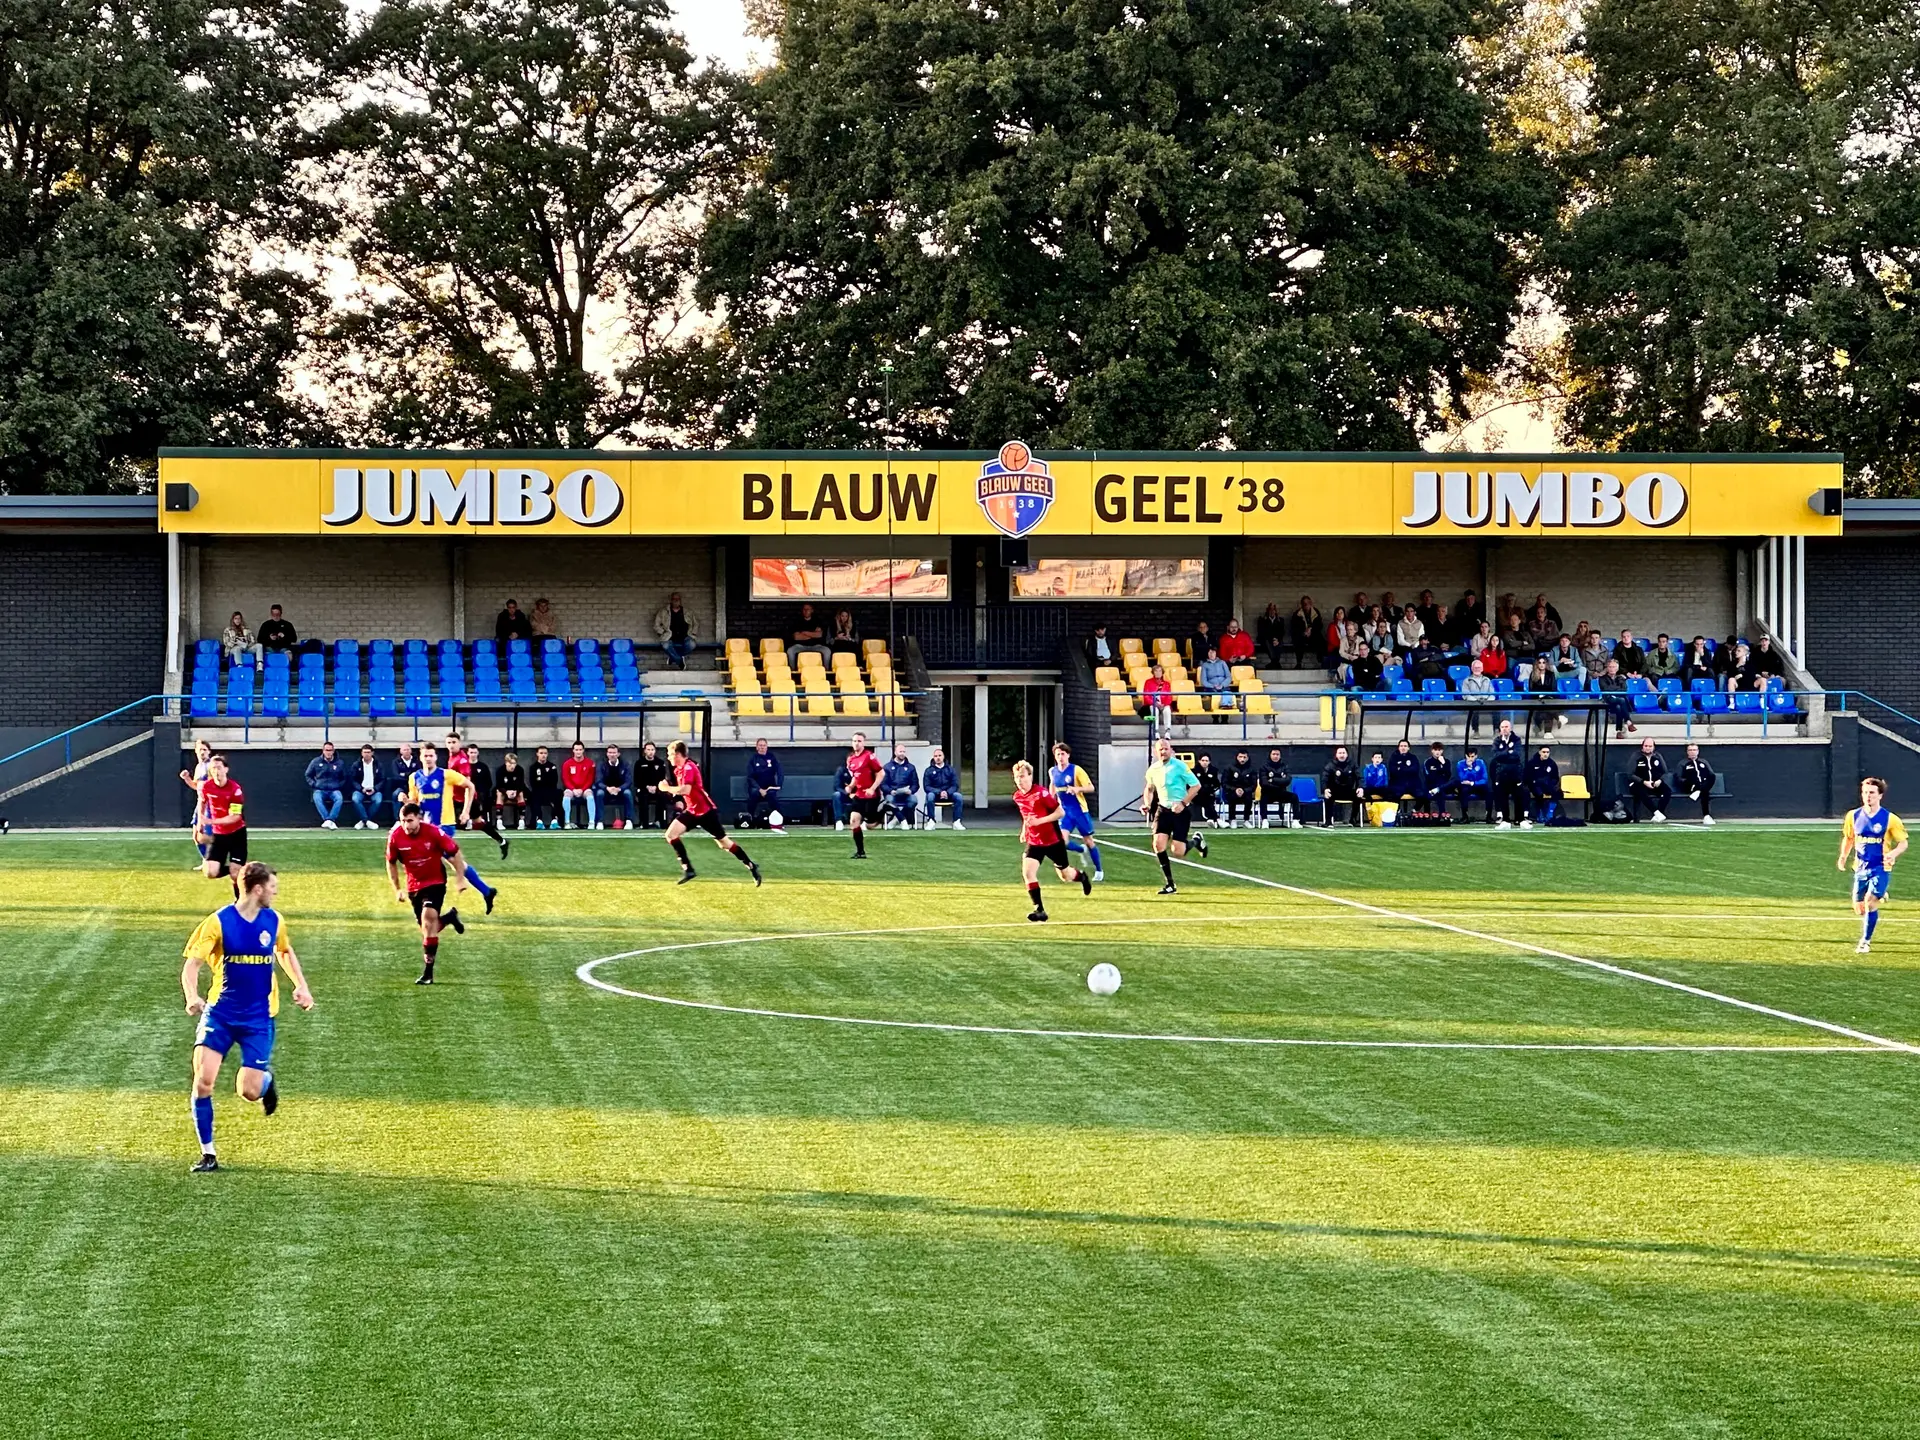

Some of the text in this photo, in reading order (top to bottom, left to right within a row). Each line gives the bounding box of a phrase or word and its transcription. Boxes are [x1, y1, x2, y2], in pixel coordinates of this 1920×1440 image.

[321, 468, 624, 526] JUMBO
[743, 473, 1285, 523] BLAUW GEEL'38
[980, 475, 1051, 496] BLAUW GEEL
[1402, 471, 1688, 528] JUMBO
